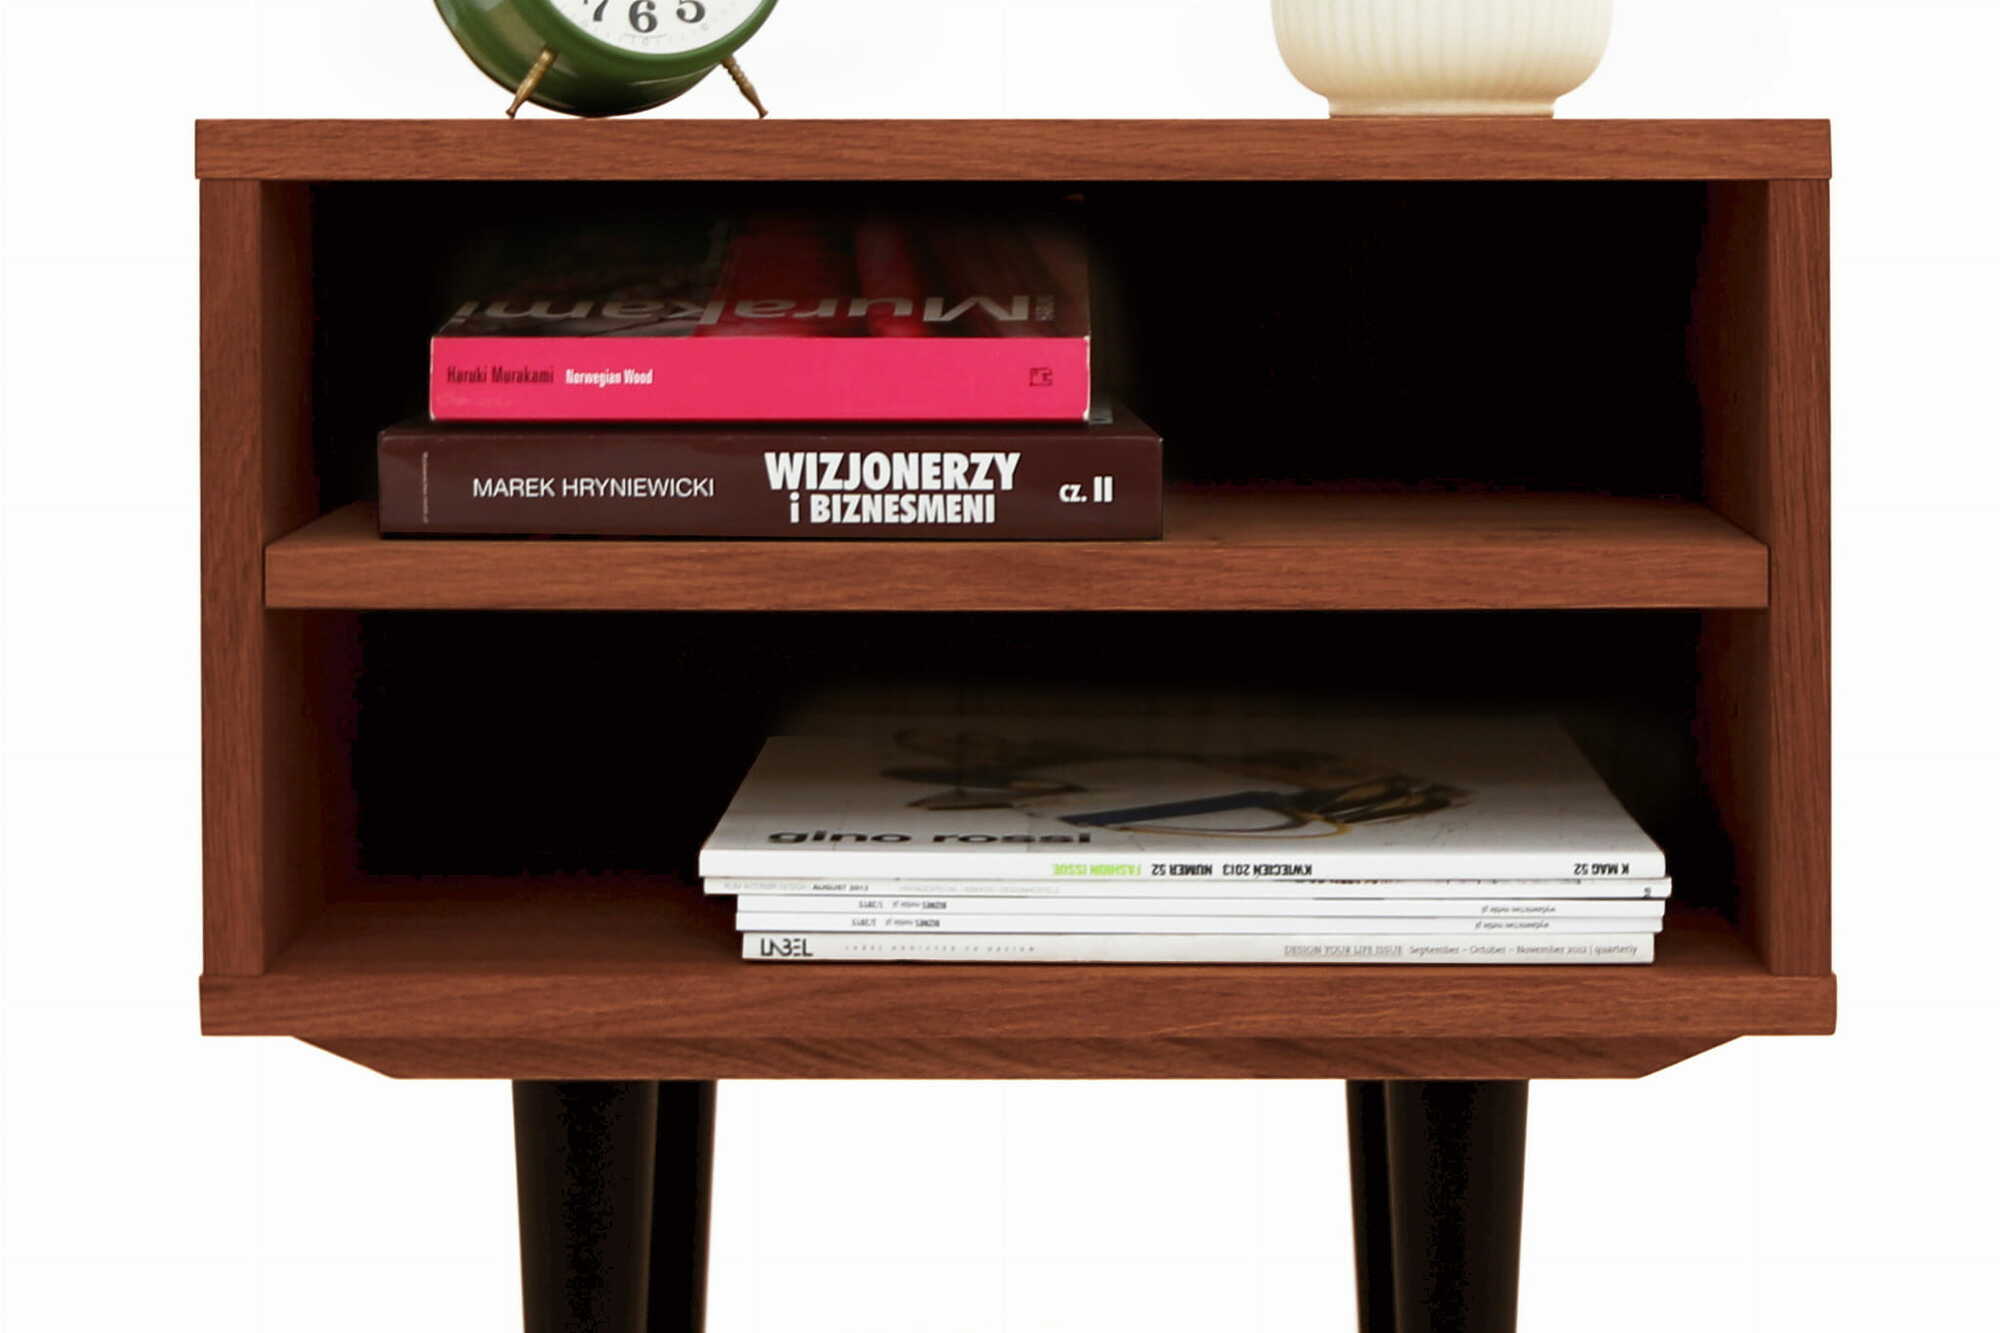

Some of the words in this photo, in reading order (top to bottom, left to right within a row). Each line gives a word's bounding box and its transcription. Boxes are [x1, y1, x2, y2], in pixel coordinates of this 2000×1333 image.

[629, 0, 658, 33] 6
[676, 0, 705, 24] 5
[443, 295, 1031, 328] Murakami
[448, 365, 487, 383] Haruki
[492, 365, 554, 383] Murakami
[566, 367, 622, 388] Norwegian
[623, 367, 654, 385] Wood
[764, 452, 1021, 490] WIZJONERZY
[473, 477, 556, 498] MAREK
[562, 477, 715, 498] HRYNIEWICKI
[1058, 483, 1088, 503] cz.
[1094, 476, 1114, 502] II
[790, 492, 800, 523] i
[811, 494, 996, 523] BIZNESMENI
[768, 829, 911, 844] gino
[932, 832, 1090, 844] rossi
[1052, 863, 1087, 876] ISSUE
[1090, 863, 1141, 876] FASHION
[1151, 863, 1165, 876] 52
[1169, 863, 1212, 876] NUMER
[1222, 863, 1249, 876] 2013
[1252, 863, 1312, 878] KWIECIEŃ
[1592, 862, 1618, 875] MAG
[1621, 862, 1629, 874] K
